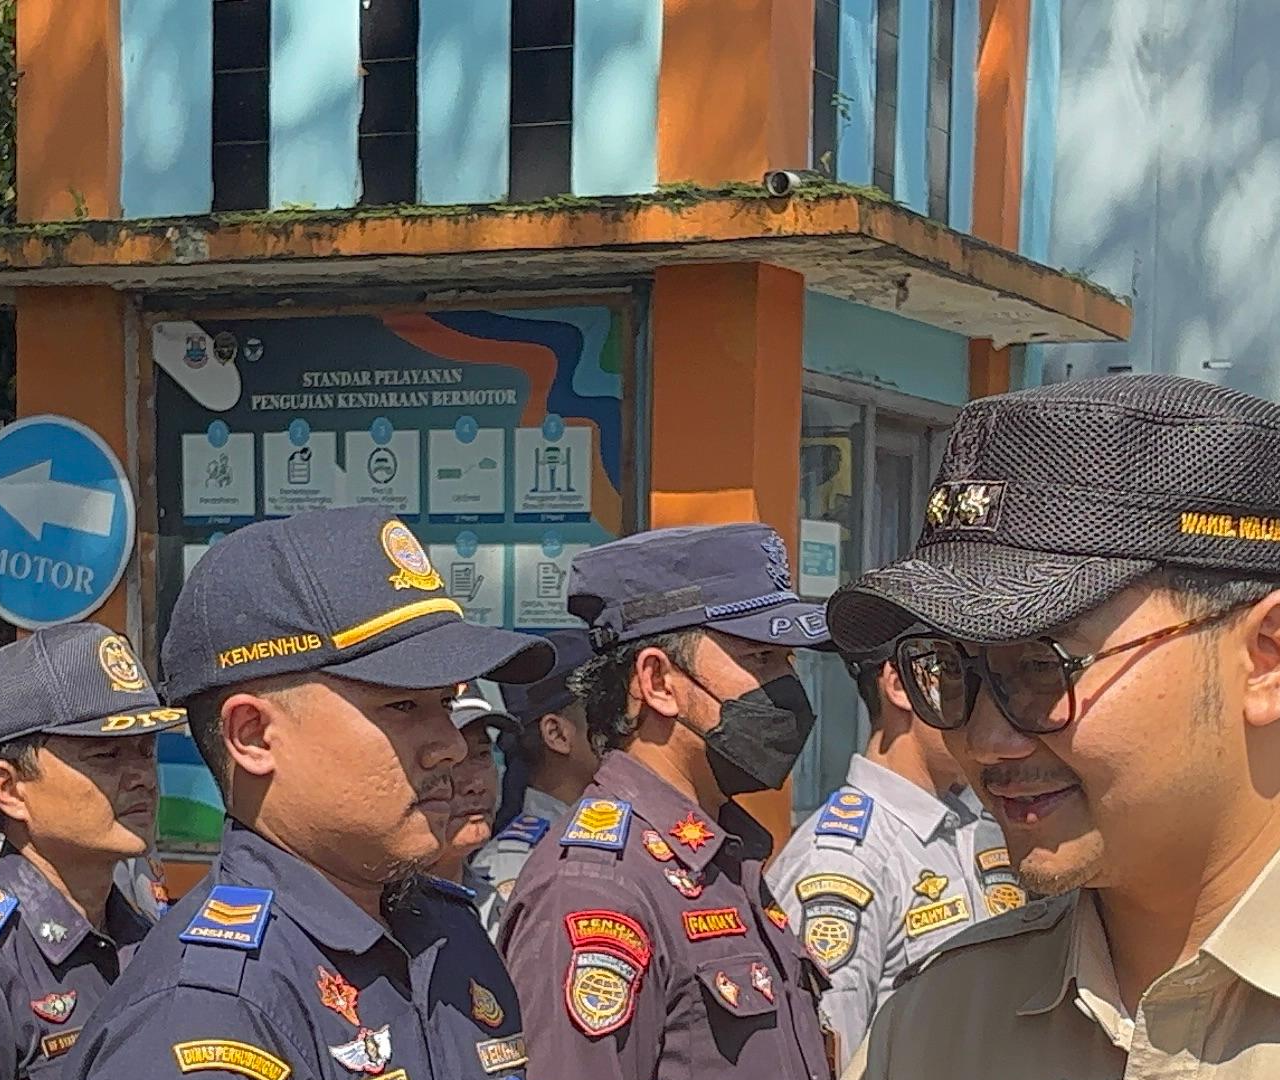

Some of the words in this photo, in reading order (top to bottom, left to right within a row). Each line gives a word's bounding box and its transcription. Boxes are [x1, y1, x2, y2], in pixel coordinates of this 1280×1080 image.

[302, 370, 371, 388] STANDAR
[375, 367, 462, 386] PELAYANAN
[251, 391, 334, 411] PENGUJIAN
[337, 389, 429, 409] KENDARAAN
[431, 387, 518, 408] BERMOTOR
[220, 633, 322, 668] KEMENHUB
[183, 1046, 215, 1065] DINAS
